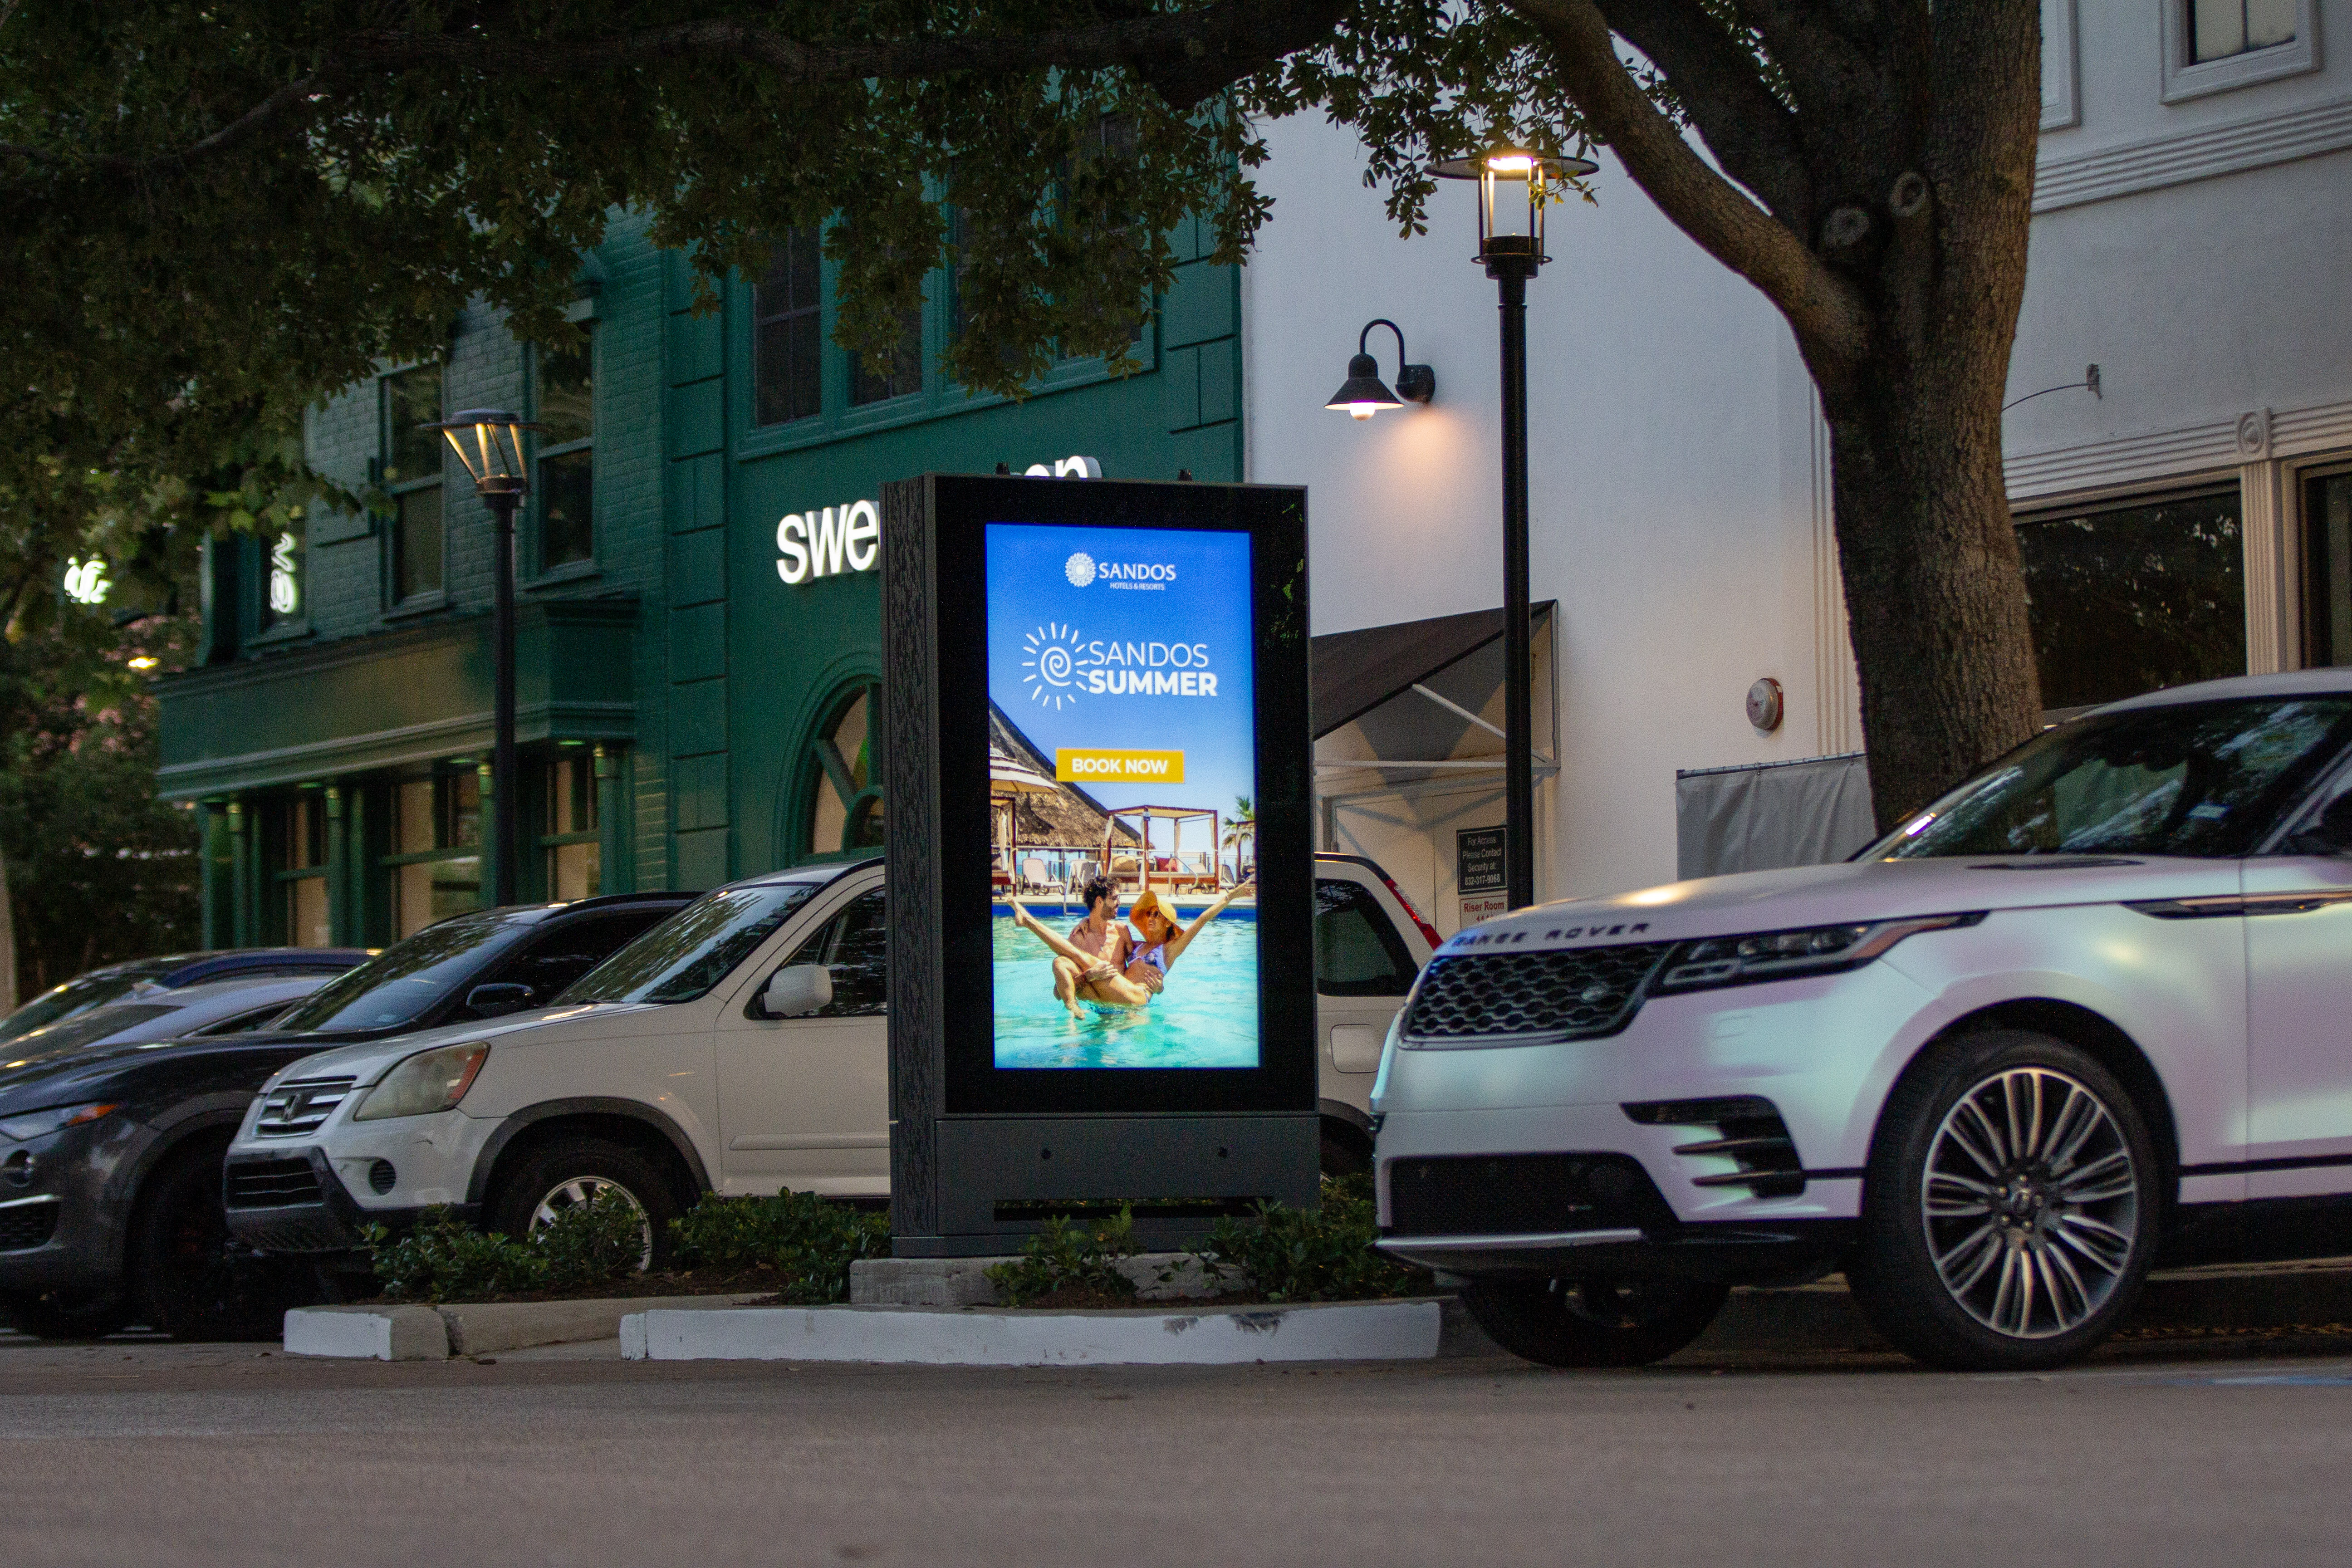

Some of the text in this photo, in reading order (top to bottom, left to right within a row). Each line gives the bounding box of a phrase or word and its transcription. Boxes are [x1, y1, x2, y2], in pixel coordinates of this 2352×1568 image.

[1098, 562, 1176, 581] SANDOS
[1139, 583, 1165, 591] RESORTS
[1088, 641, 1209, 668] SANDOS
[1088, 669, 1218, 696] SUMMER
[1072, 758, 1168, 774] BOOK NOW
[1467, 835, 1496, 846] For Access
[1462, 848, 1501, 860] Please Contact
[1467, 863, 1489, 873] Security
[1464, 901, 1504, 913] Riser Room
